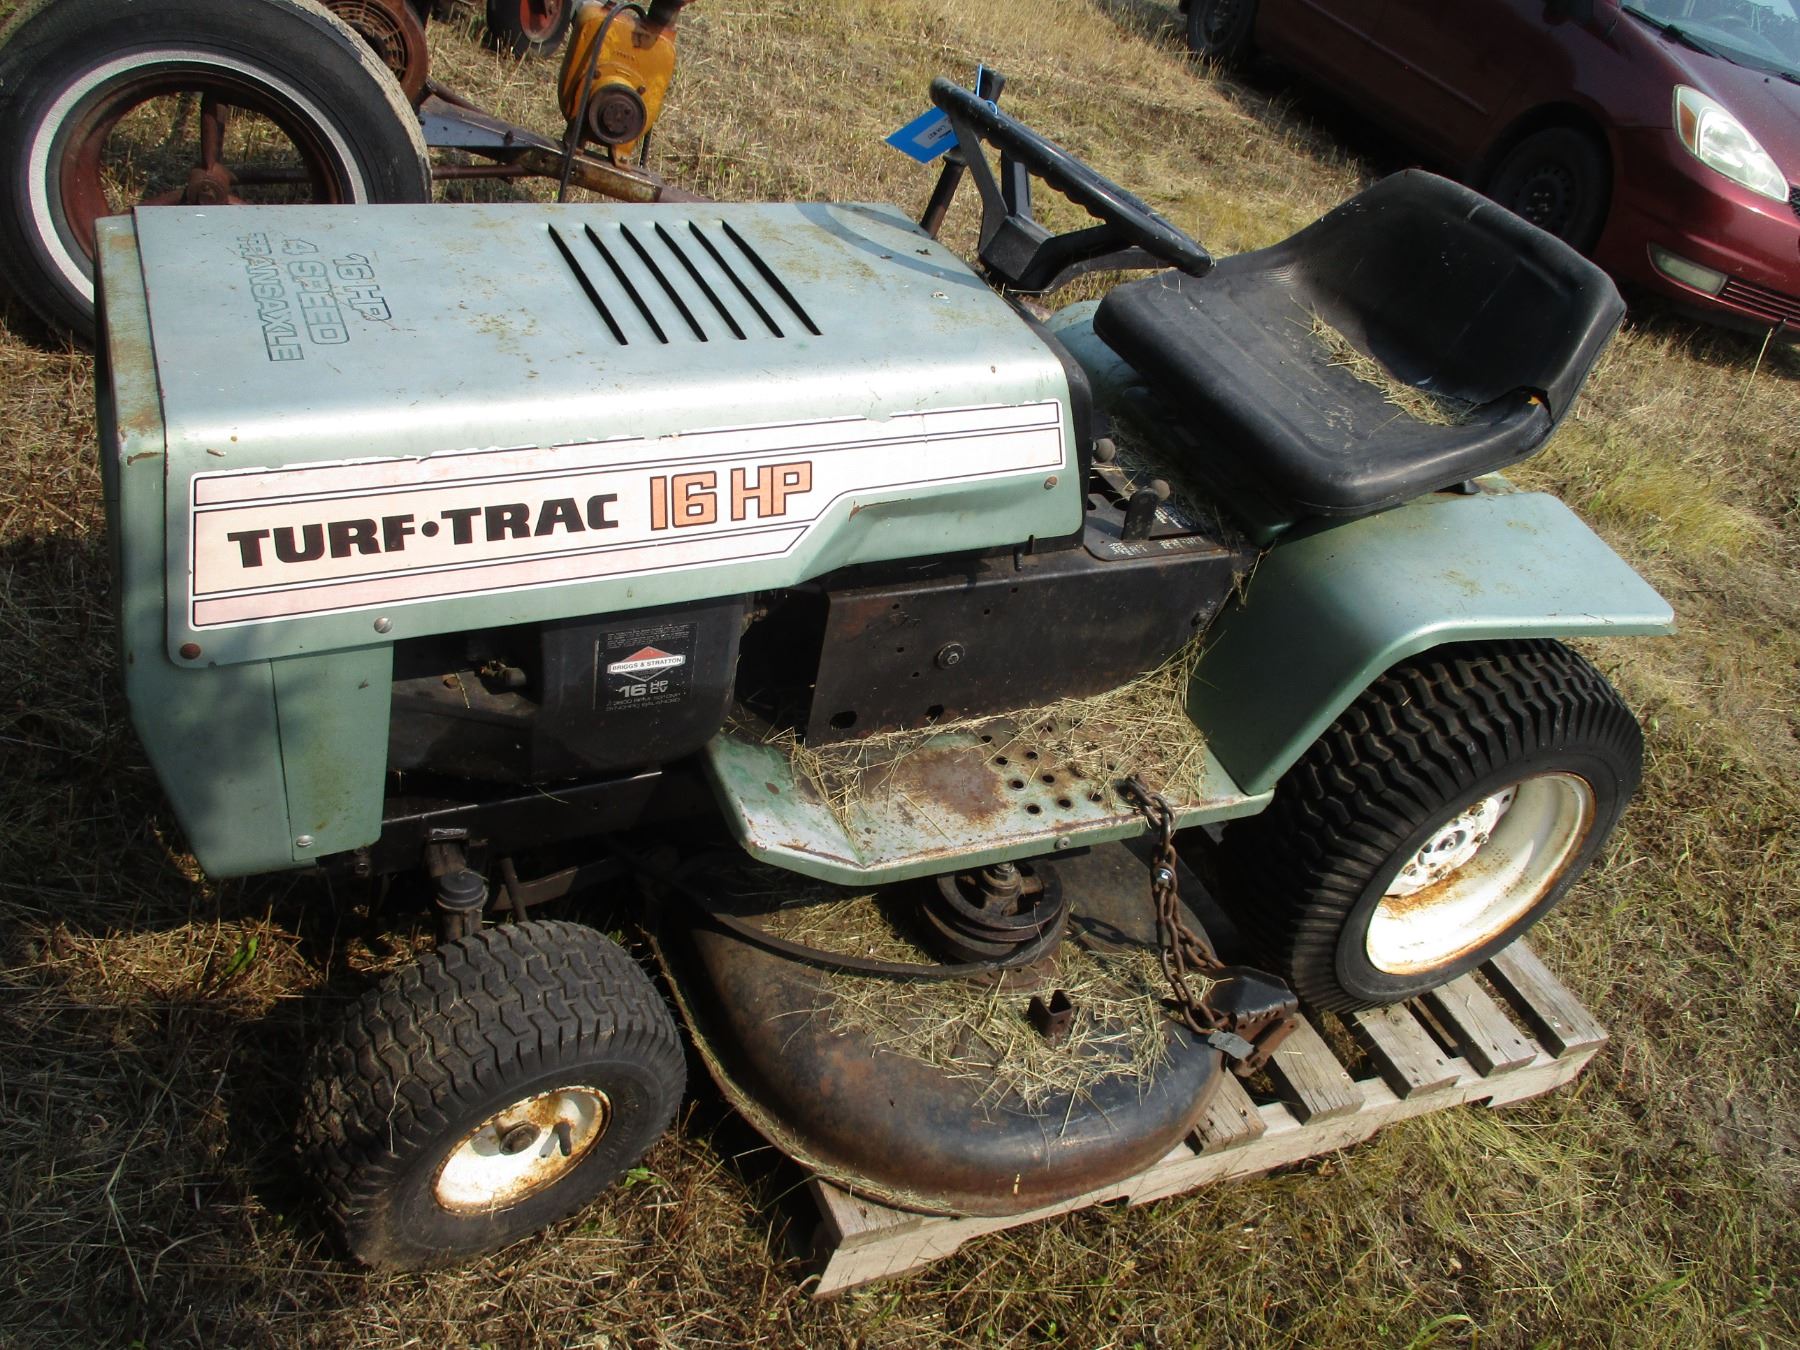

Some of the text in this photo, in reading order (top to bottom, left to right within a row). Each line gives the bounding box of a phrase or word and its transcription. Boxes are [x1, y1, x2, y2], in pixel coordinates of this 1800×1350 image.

[237, 232, 304, 361] TRANSAXLE
[282, 239, 350, 344] 4 SPEED
[333, 253, 392, 321] 16 HP
[650, 471, 717, 530] 16
[730, 461, 813, 522] HP
[616, 683, 647, 698] 16
[647, 657, 682, 666] STRATTON
[650, 686, 668, 694] CV
